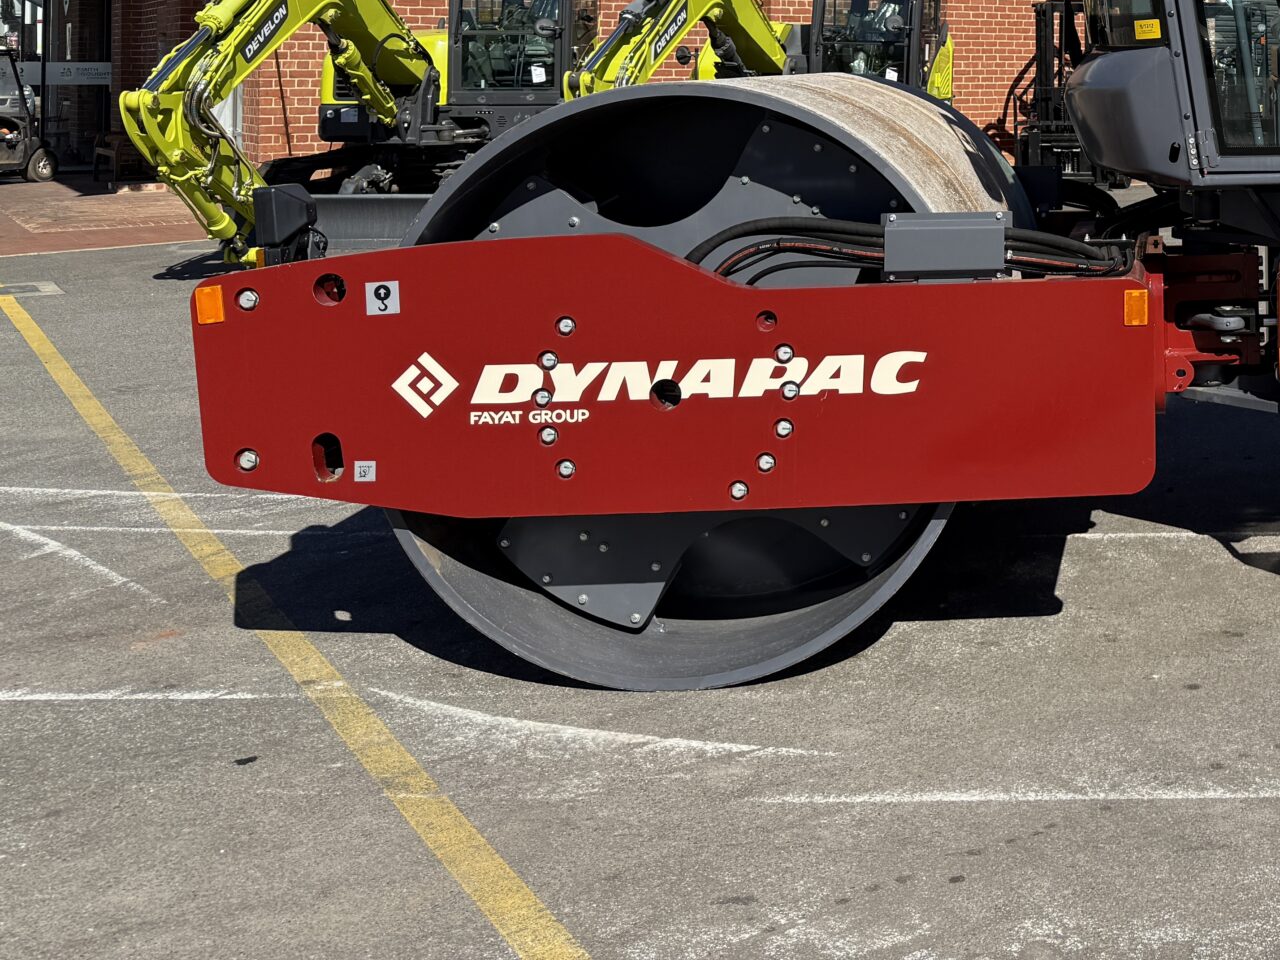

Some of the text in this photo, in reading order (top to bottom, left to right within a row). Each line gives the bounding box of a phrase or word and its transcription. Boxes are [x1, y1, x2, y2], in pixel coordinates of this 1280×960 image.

[245, 4, 287, 59] DEVELON
[656, 9, 687, 54] DEVELON
[470, 351, 928, 405] DYNAPAC
[470, 409, 590, 425] FAYAT GROUP
